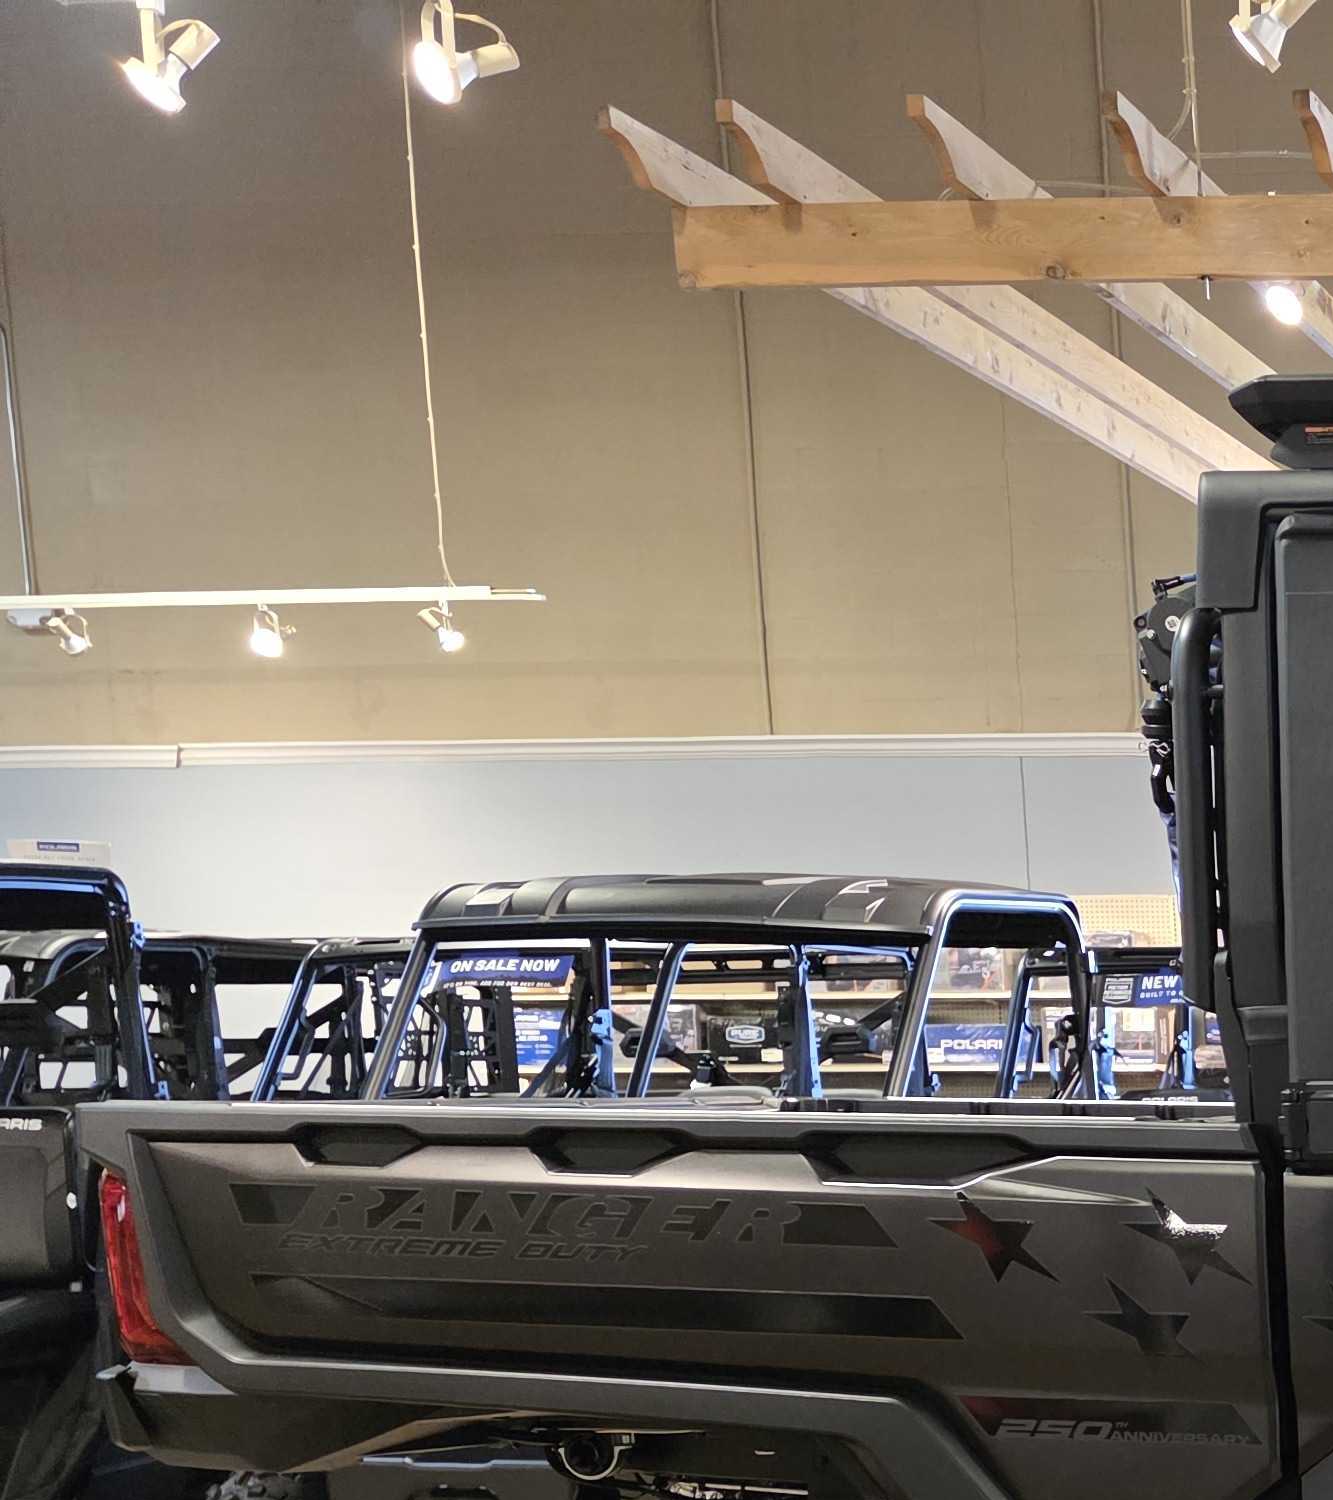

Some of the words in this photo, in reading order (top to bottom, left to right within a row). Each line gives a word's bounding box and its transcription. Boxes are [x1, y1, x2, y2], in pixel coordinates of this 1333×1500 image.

[450, 960, 474, 973] ON
[474, 959, 519, 972] SALE
[519, 958, 561, 972] NOW
[1141, 975, 1179, 990] NEW
[290, 1184, 803, 1245] RANGER
[277, 1230, 506, 1260] EXTREME
[510, 1239, 652, 1265] DUTY
[1110, 1429, 1253, 1448] ANNIVERSARY
